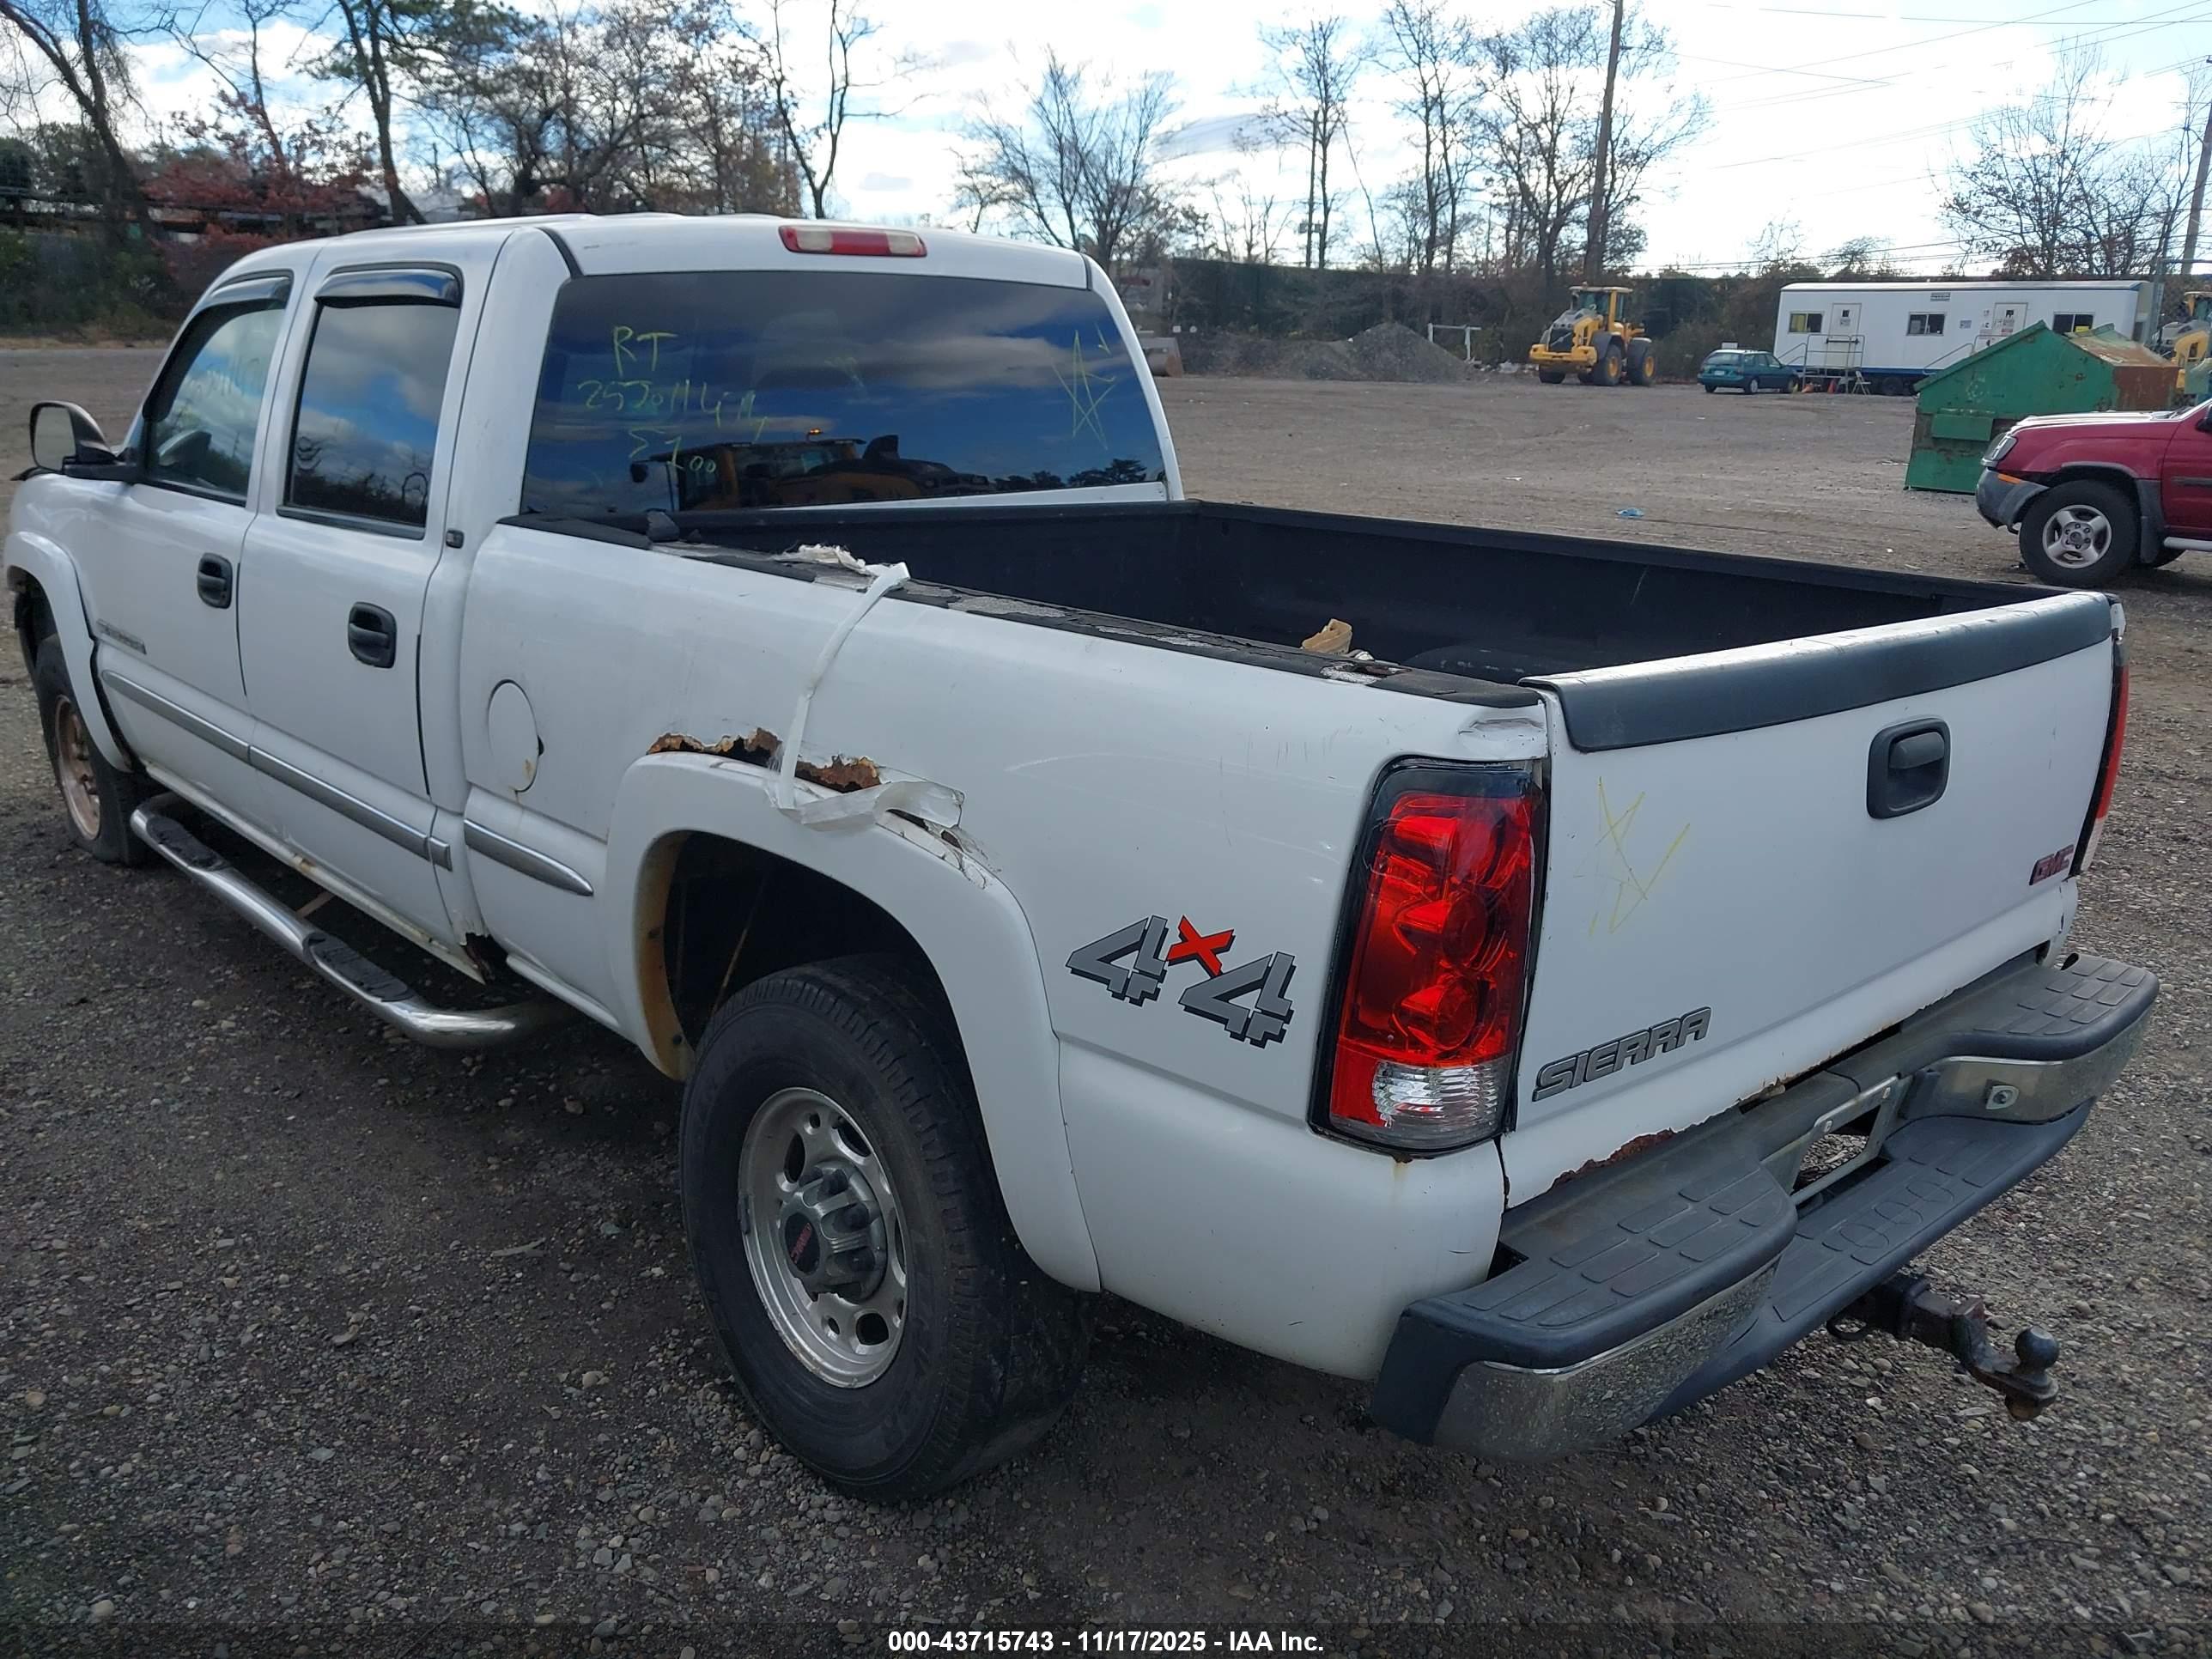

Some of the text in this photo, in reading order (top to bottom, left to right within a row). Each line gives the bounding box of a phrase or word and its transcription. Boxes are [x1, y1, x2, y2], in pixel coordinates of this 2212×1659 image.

[611, 325, 678, 375] RT
[2029, 844, 2075, 885] GMC
[1532, 1006, 1711, 1102] SIERRA
